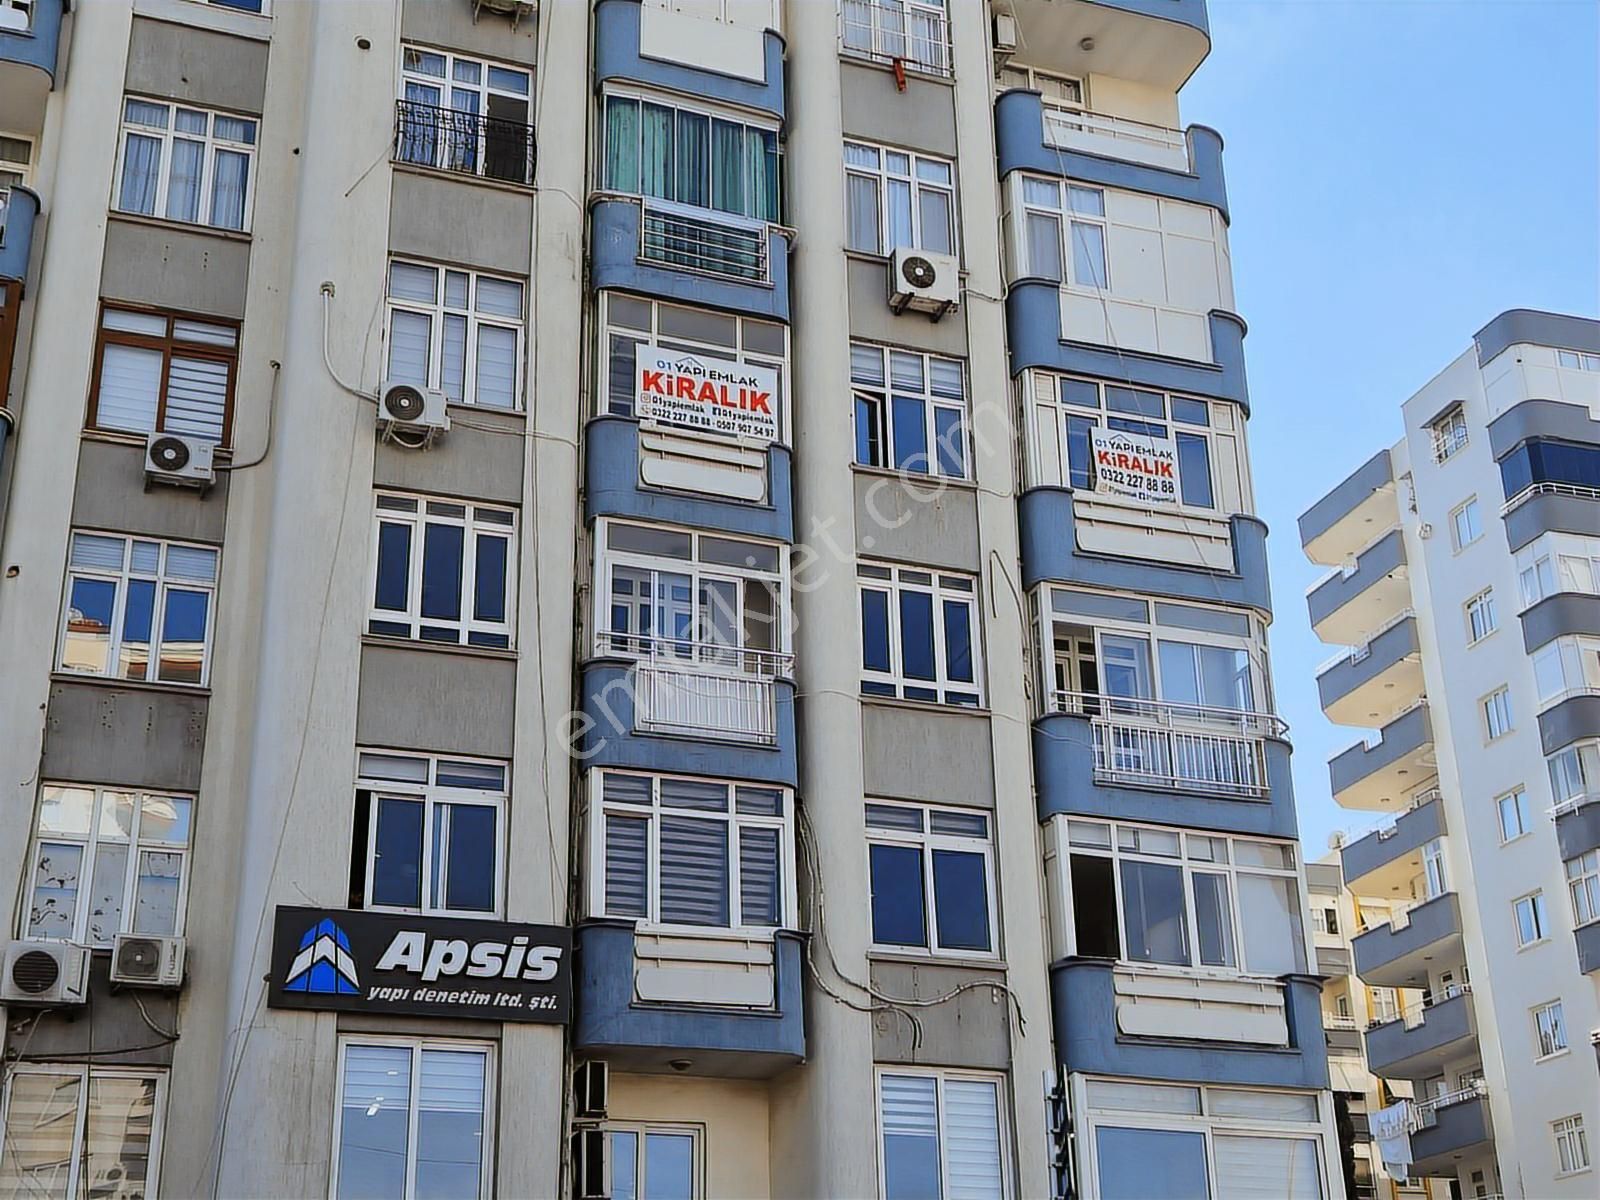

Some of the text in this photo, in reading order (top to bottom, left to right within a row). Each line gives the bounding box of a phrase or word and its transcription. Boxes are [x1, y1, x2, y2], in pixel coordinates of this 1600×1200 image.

[657, 360, 758, 387] 01 YAPI EMLAK
[652, 407, 671, 419] 0322
[673, 411, 687, 422] 227
[1108, 440, 1134, 452] YAPI
[1136, 445, 1173, 460] EMLAK
[1101, 468, 1125, 484] 0322
[1127, 473, 1144, 489] 227
[1146, 477, 1158, 492] 88
[1161, 480, 1174, 494] 88
[375, 930, 563, 982] Apsis
[367, 985, 558, 1011] yapı denetim ltd. şti.
